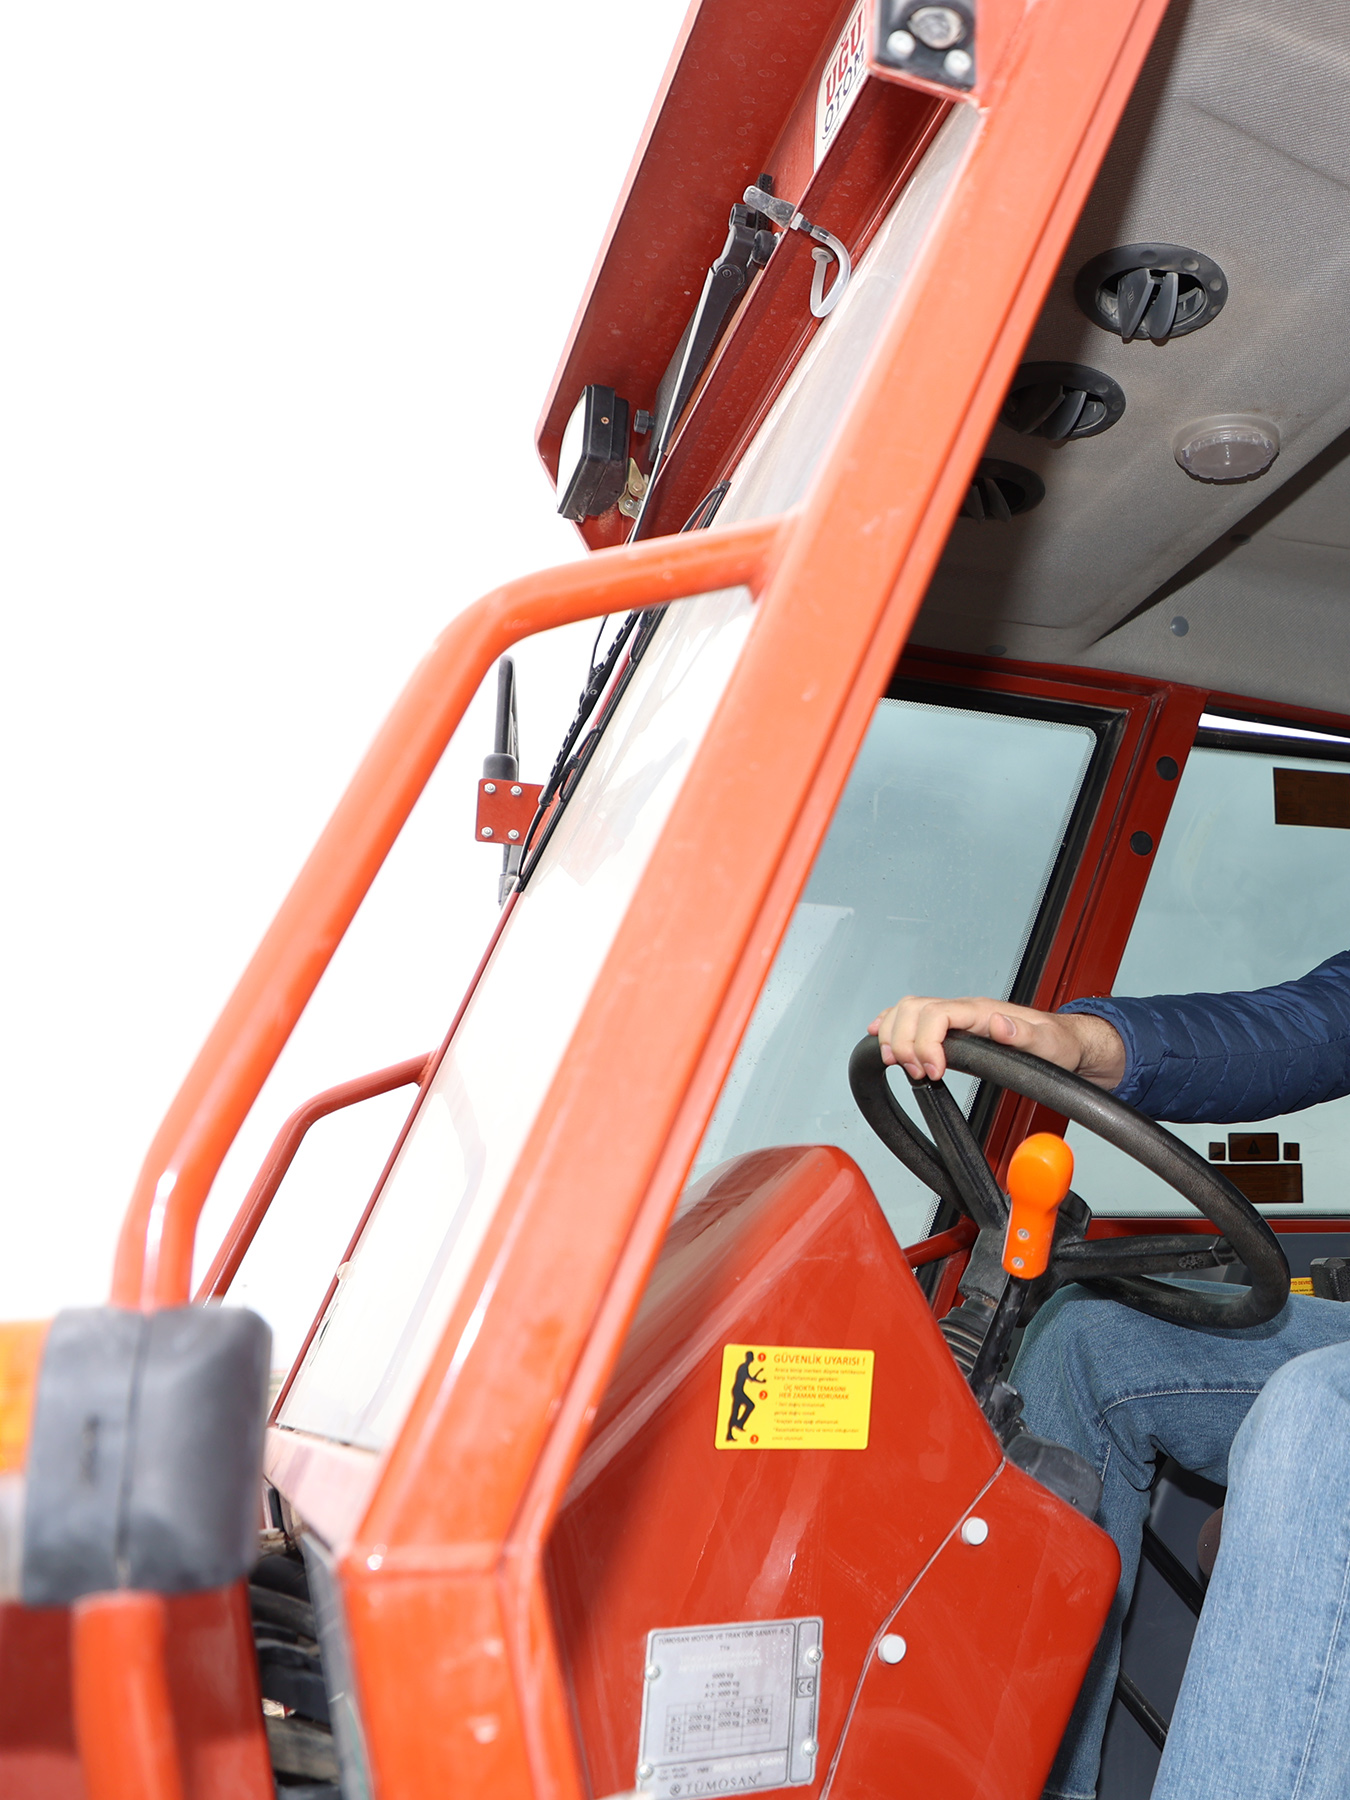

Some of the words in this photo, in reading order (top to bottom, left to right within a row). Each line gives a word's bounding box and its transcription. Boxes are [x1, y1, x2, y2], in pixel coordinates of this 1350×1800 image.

[826, 2, 867, 106] UĞU
[773, 1352, 821, 1364] GÜVENLİK
[824, 1355, 860, 1366] UYARISI
[783, 1383, 793, 1393] ÜÇ
[691, 1634, 714, 1642] MOTOR
[724, 1630, 754, 1639] TRAKTÖR
[686, 1776, 757, 1794] TÜMOSAN
